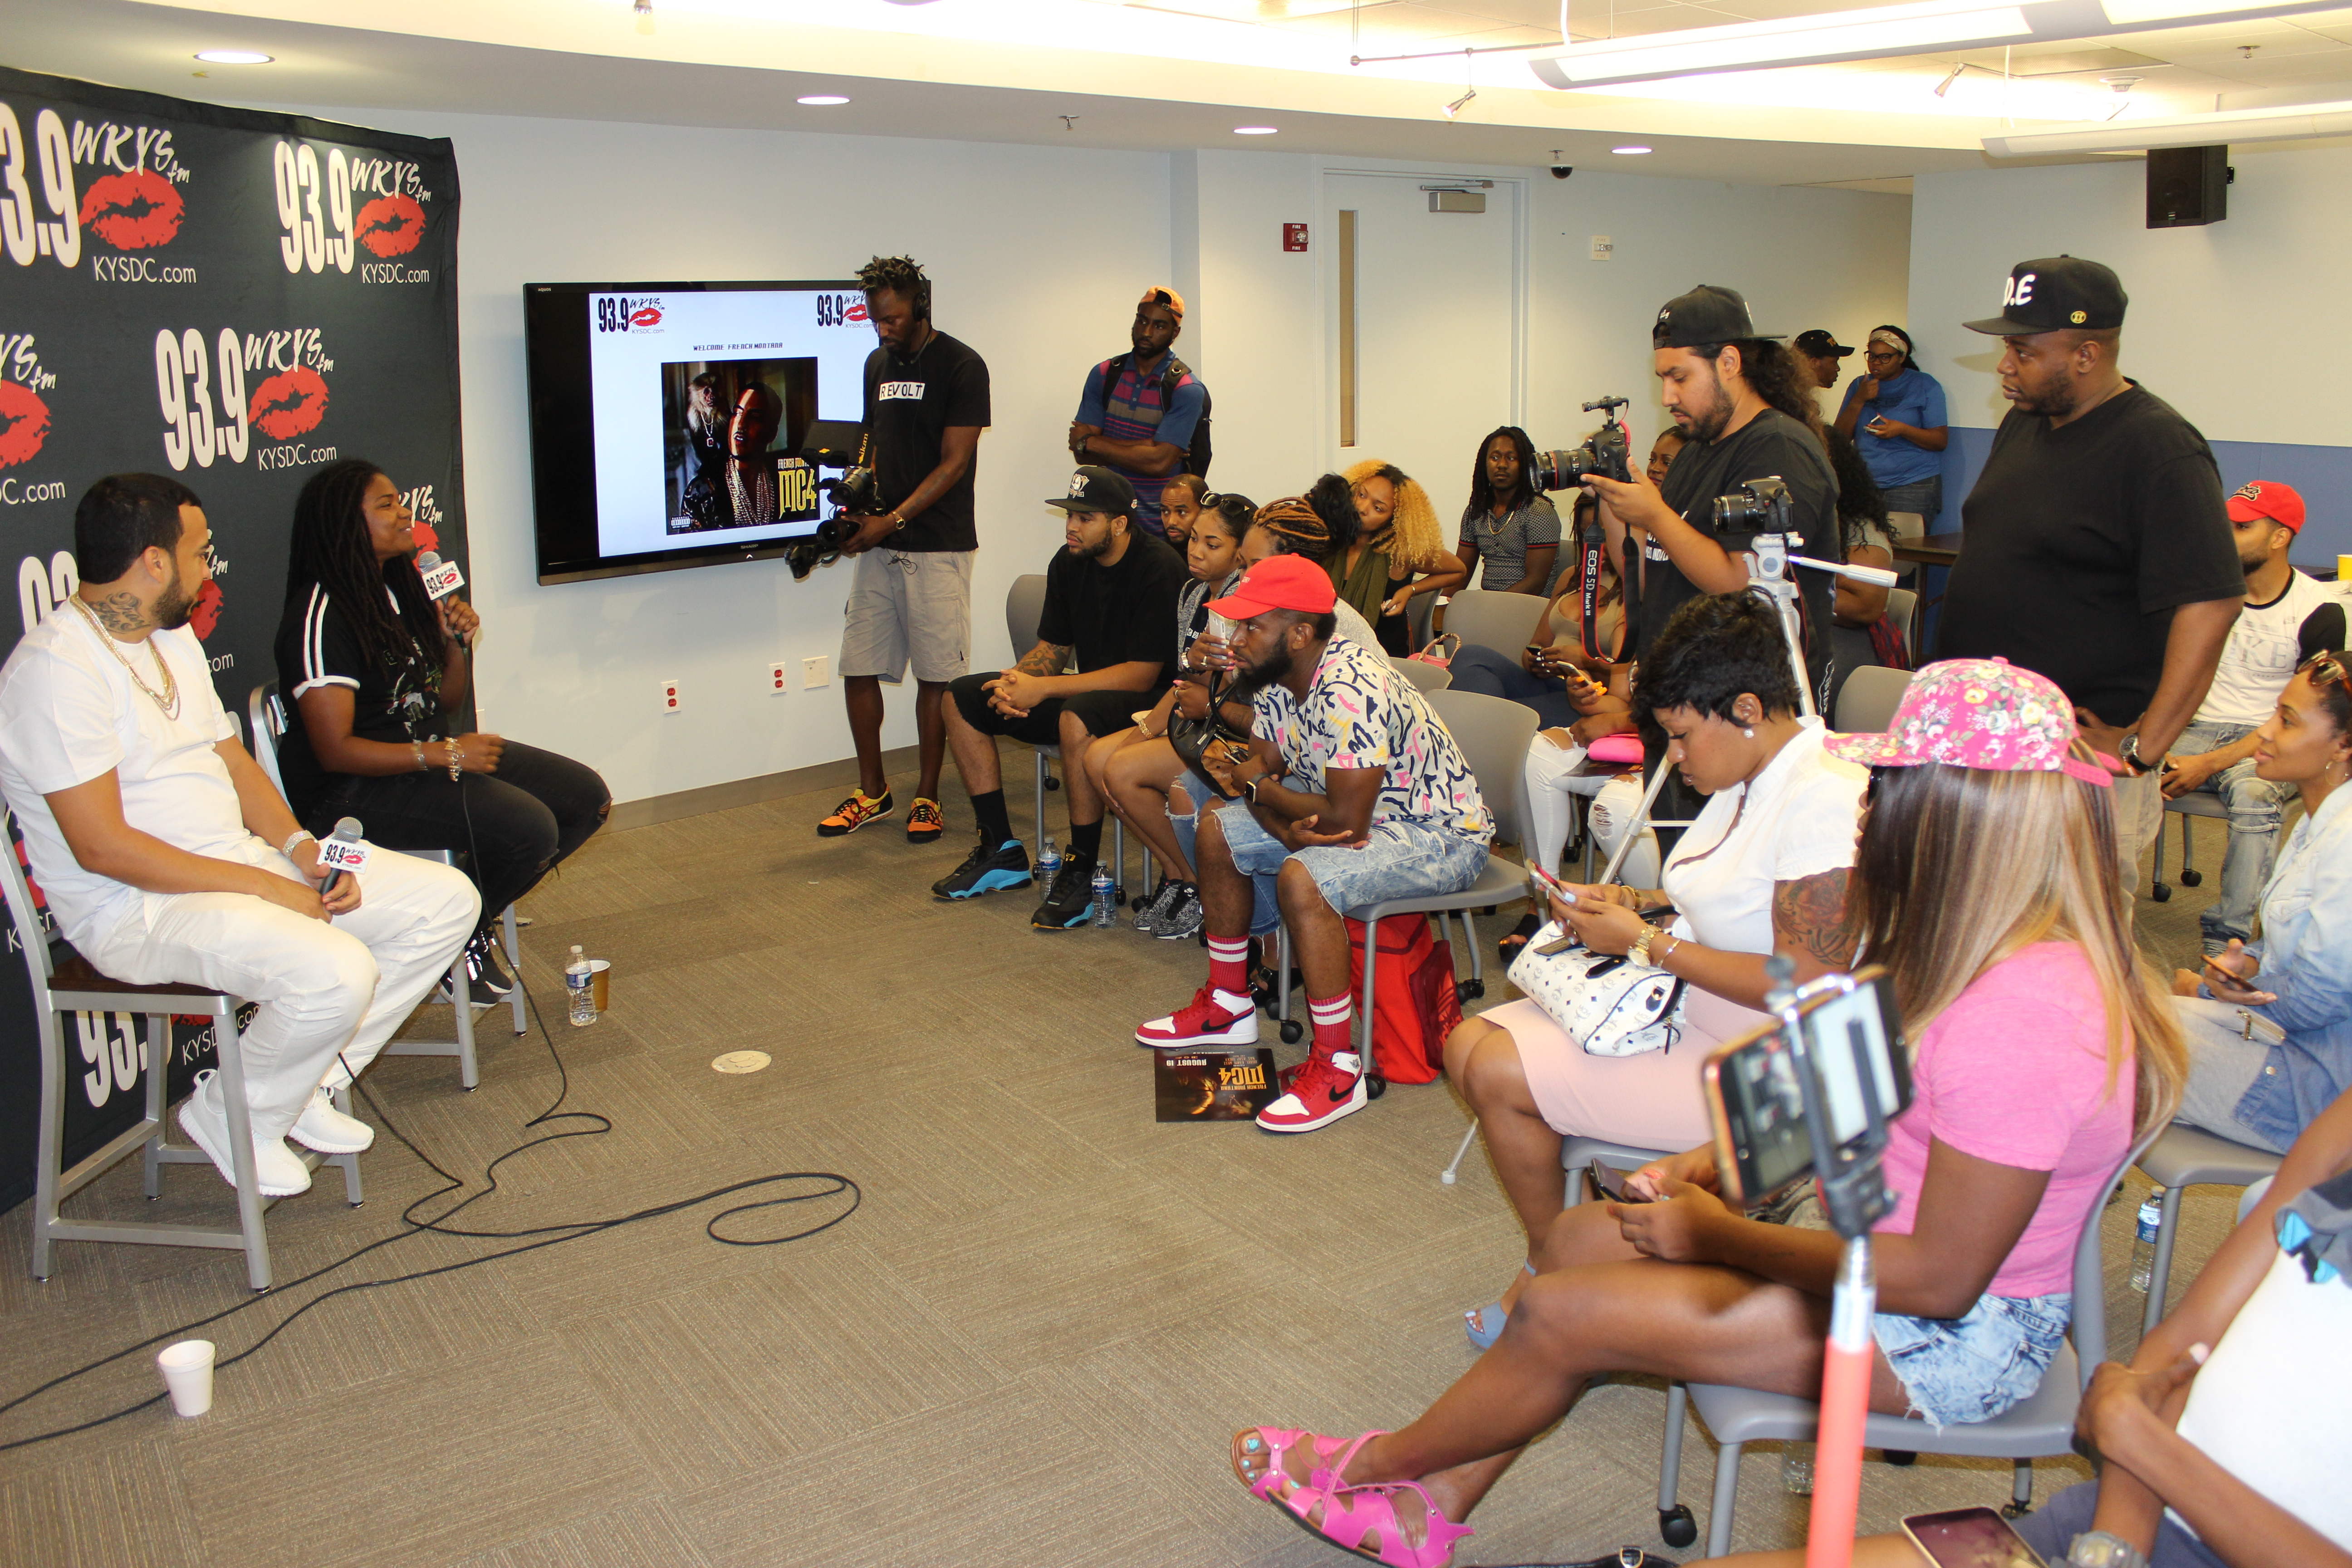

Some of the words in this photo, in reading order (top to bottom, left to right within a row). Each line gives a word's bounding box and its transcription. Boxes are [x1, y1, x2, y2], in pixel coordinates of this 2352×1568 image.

[73, 120, 175, 176] WKYS
[0, 102, 81, 269] 3.9
[351, 157, 421, 199] WKYS
[415, 186, 431, 203] fm
[274, 141, 355, 274] 93.9
[93, 255, 196, 284] KYSDC.com
[362, 263, 430, 284] KYSDC.com
[598, 297, 629, 333] 93.9
[629, 298, 660, 309] WKYS
[817, 294, 843, 327] 93.9
[844, 295, 866, 305] WKY
[0, 334, 39, 389] YS
[245, 328, 323, 373] WKYS
[316, 356, 334, 373] fm
[156, 327, 249, 471] 93.9
[881, 384, 923, 398] REVOLT
[258, 443, 337, 471] KYSDC.com
[0, 478, 66, 505] C.com
[399, 485, 435, 528] YS
[778, 469, 817, 519] MC4
[1587, 550, 1597, 575] EOS
[426, 574, 444, 594] 93.9
[1586, 578, 1596, 590] 5D
[324, 844, 346, 864] 93.9
[1218, 1063, 1266, 1085] MC4
